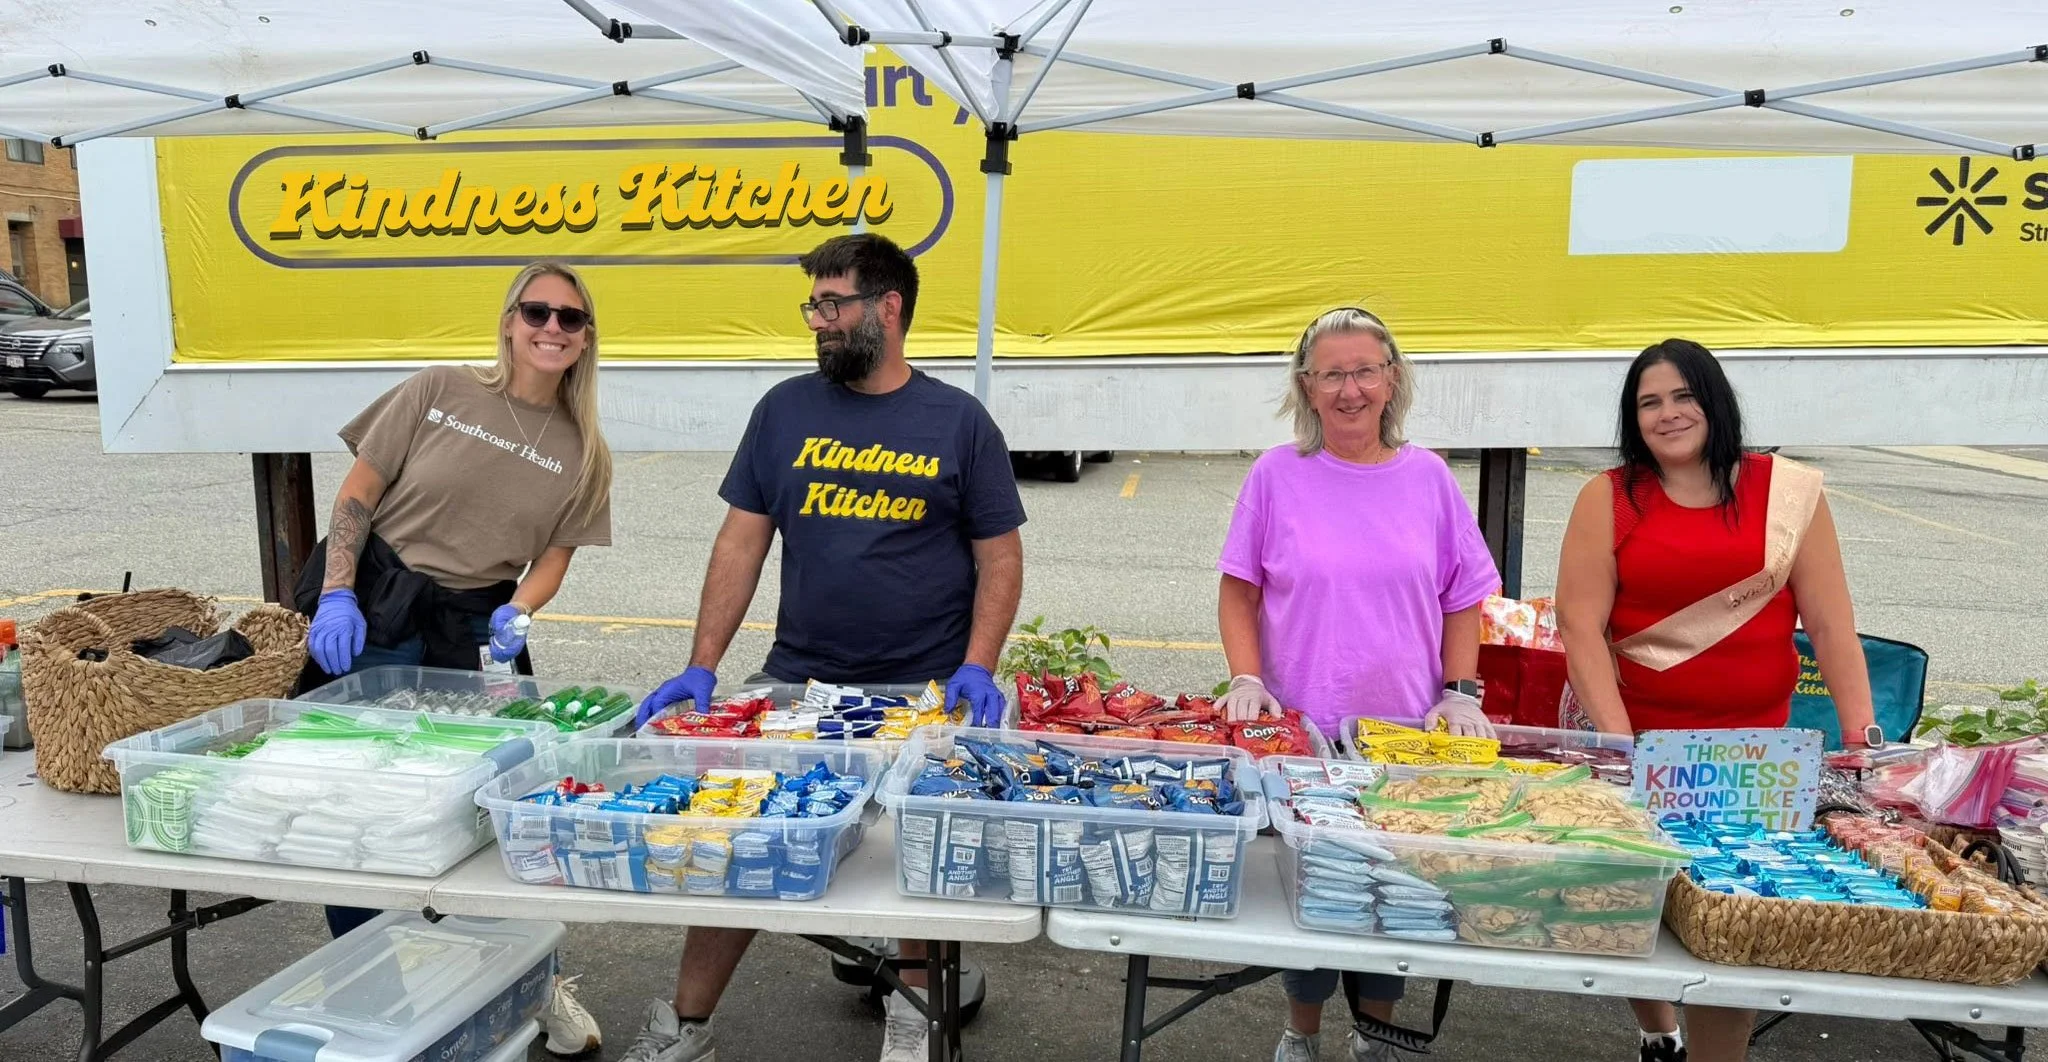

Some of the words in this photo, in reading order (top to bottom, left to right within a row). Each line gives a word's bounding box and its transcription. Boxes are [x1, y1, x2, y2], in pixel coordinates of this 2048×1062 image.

[269, 167, 599, 240] Kindness
[618, 161, 893, 231] Kitchen
[444, 414, 519, 453] Southcoast
[520, 445, 563, 474] Health
[792, 437, 940, 478] Kindness
[799, 482, 927, 521] Kitchen
[1683, 743, 1768, 762] THROW
[1645, 760, 1800, 791] KINDNESS
[1646, 789, 1740, 810] AROUND
[1746, 790, 1796, 809] LIKE
